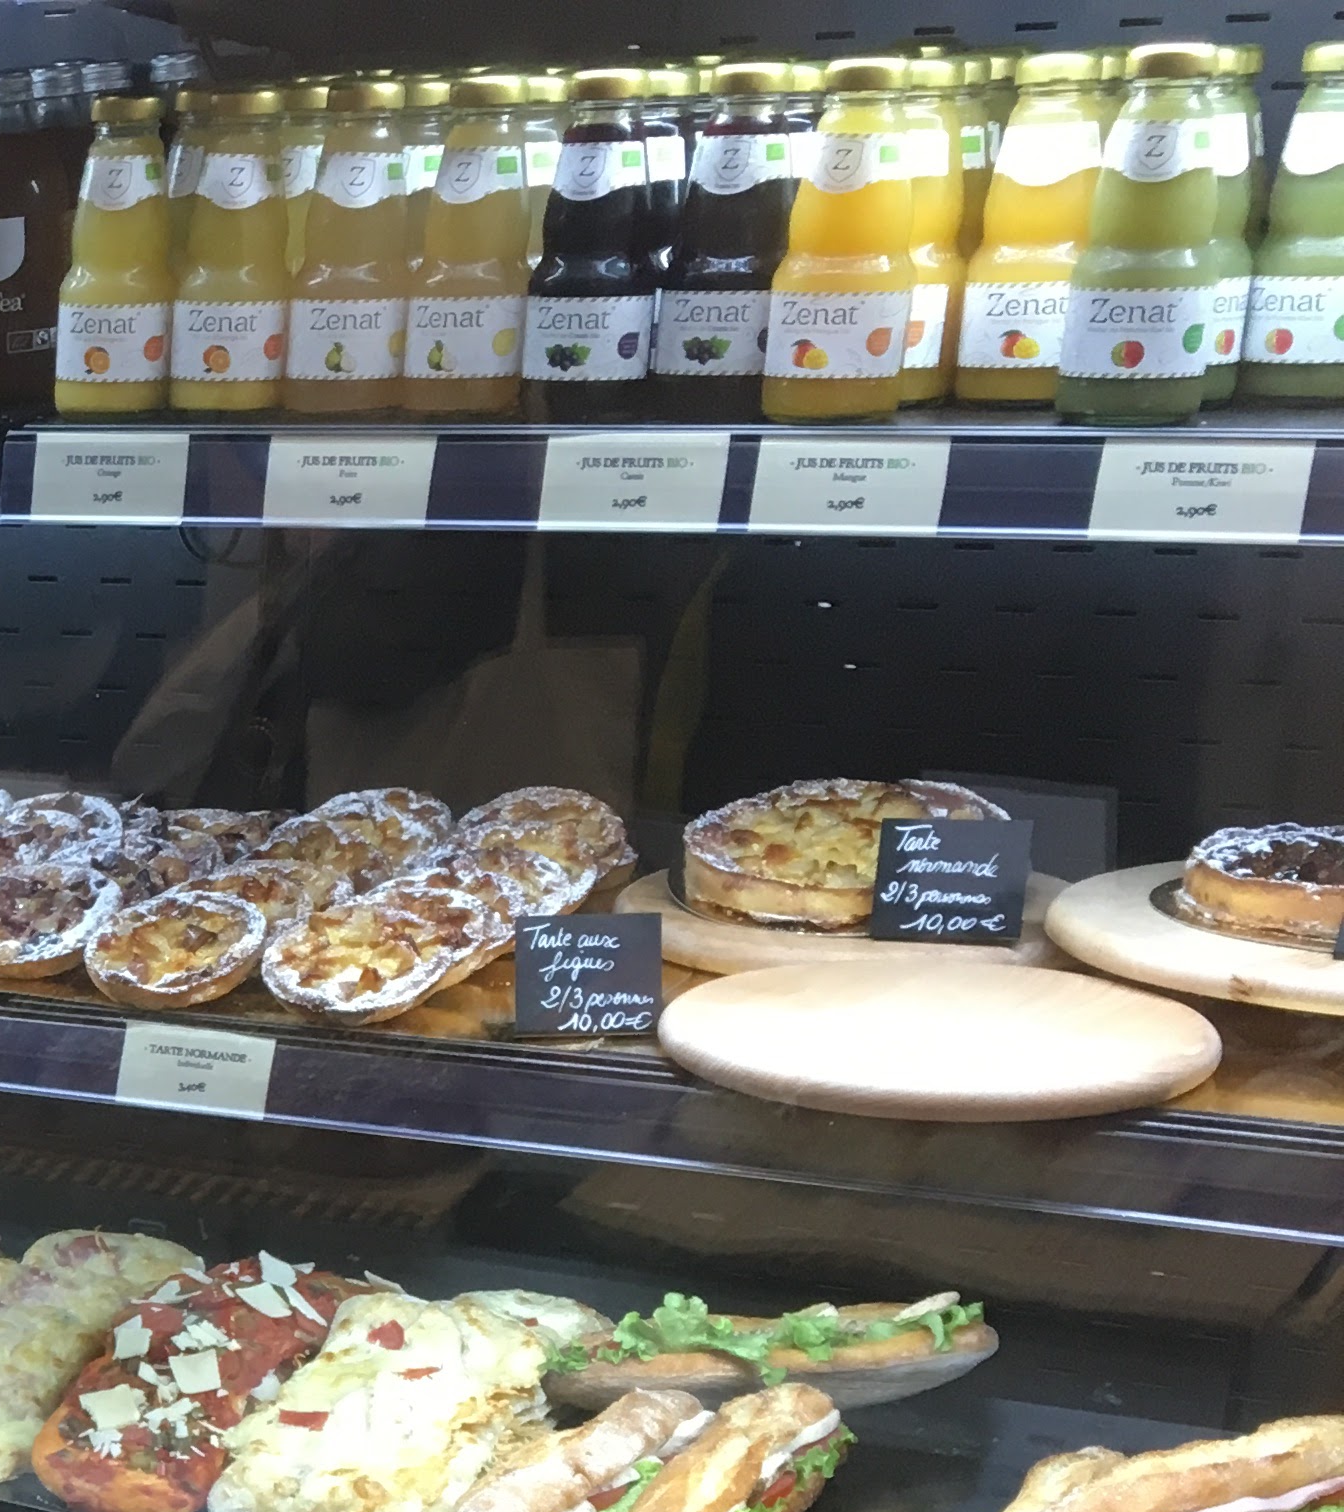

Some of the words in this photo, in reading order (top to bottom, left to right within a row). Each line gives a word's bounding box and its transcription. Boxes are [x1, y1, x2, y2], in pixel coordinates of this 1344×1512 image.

[70, 311, 136, 335] Zenat
[189, 310, 257, 332] Zenat
[310, 308, 381, 331] Zenat
[416, 305, 484, 328] Zenat
[537, 306, 610, 331] Zenat
[674, 299, 750, 324] Zenat
[782, 300, 858, 327] Zenat
[1090, 298, 1177, 324] Zenat
[66, 455, 84, 466] JUS
[85, 456, 98, 466] DE
[100, 456, 136, 466] FRUITS
[302, 455, 320, 467] JUS
[322, 456, 336, 466] DE
[338, 456, 377, 467] FRUITS
[581, 457, 602, 469] JUS
[604, 458, 620, 469] DE
[622, 458, 664, 469] FRUITS
[796, 458, 818, 470] JUS
[818, 458, 836, 469] DE
[839, 458, 884, 470] FRUITS
[1141, 462, 1166, 475] JUS
[1168, 462, 1186, 474] DE
[1189, 462, 1238, 474] FRUITS
[895, 824, 941, 851] Tarte
[896, 853, 999, 877] normande
[880, 881, 919, 904] 2/3
[914, 889, 991, 910] personnes
[523, 923, 572, 950] Tarte
[577, 933, 620, 948] aux
[539, 950, 615, 982] figues
[541, 986, 583, 1013] 2/3
[584, 992, 654, 1013] personnes
[149, 1044, 183, 1056] TARTE
[185, 1048, 247, 1063] NORMANDE
